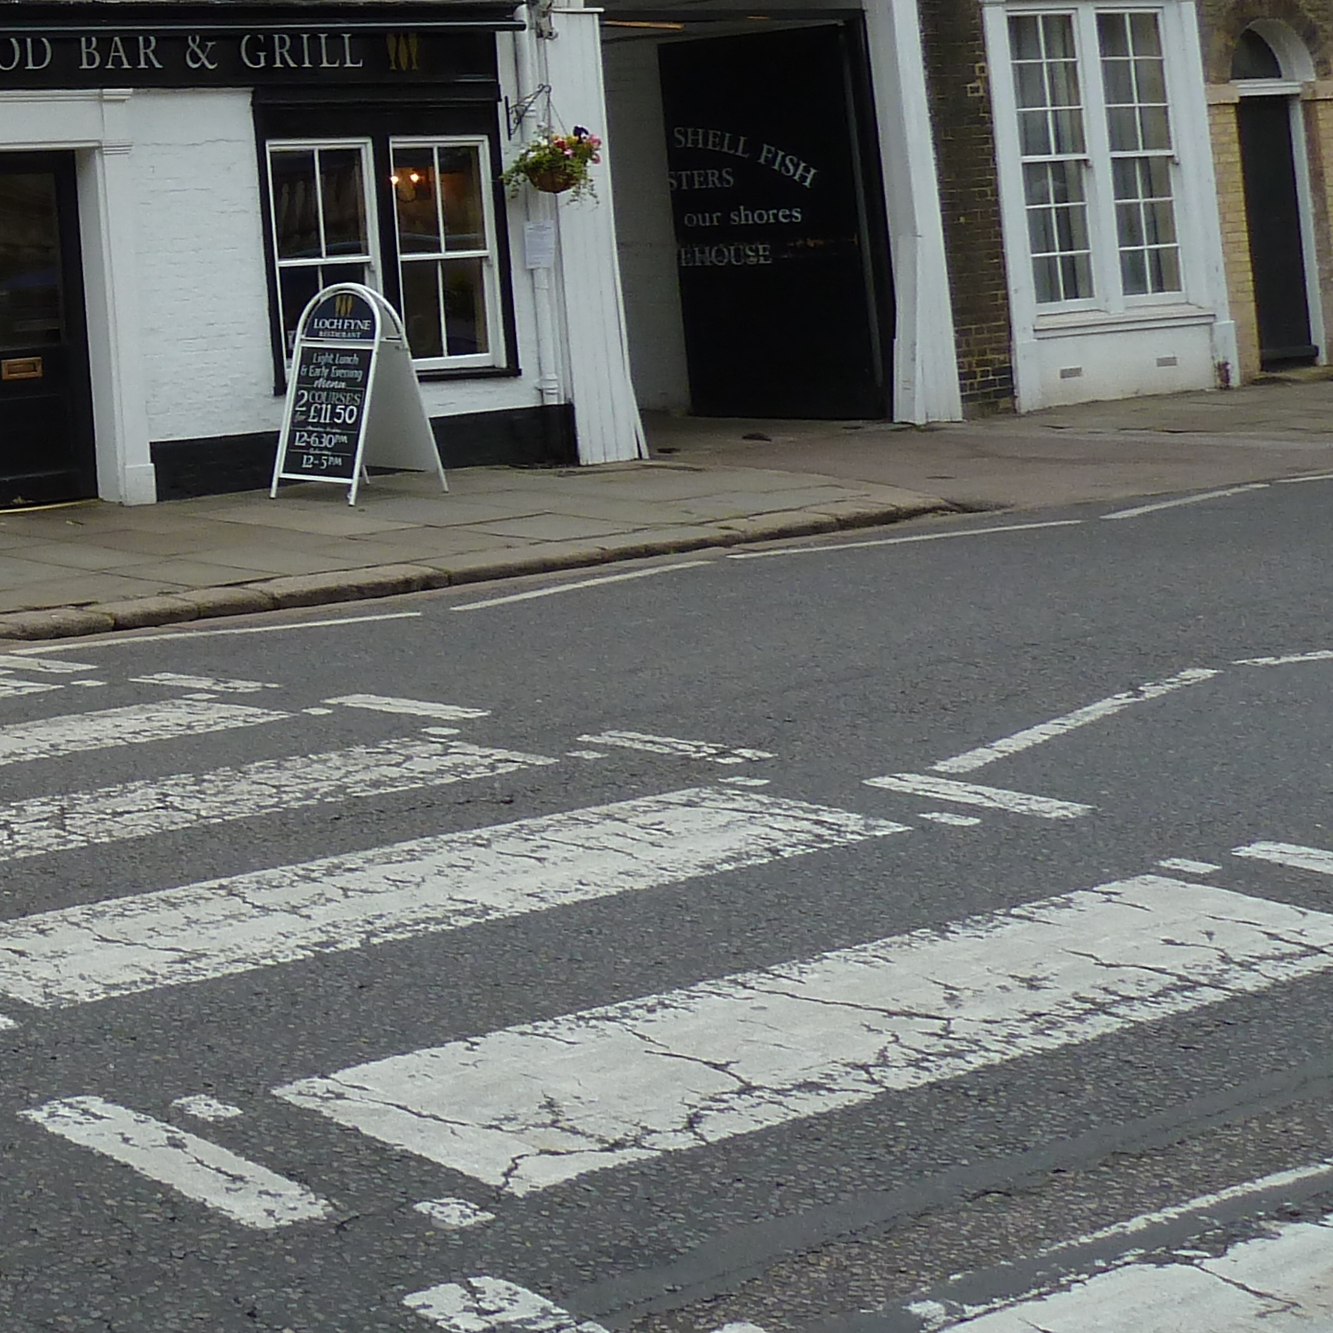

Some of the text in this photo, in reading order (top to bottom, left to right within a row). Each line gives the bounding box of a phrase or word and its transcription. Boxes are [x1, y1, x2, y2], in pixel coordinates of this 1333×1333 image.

[78, 35, 164, 70] BAR
[185, 34, 218, 70] &
[240, 33, 364, 68] GRILL
[673, 126, 819, 189] SHELL FISH
[684, 206, 802, 227] our shores
[313, 318, 372, 330] LOCH FYNE
[313, 352, 359, 366] Light Lunch
[300, 365, 363, 382] & Early Evening
[294, 389, 362, 411] 2 COURSES
